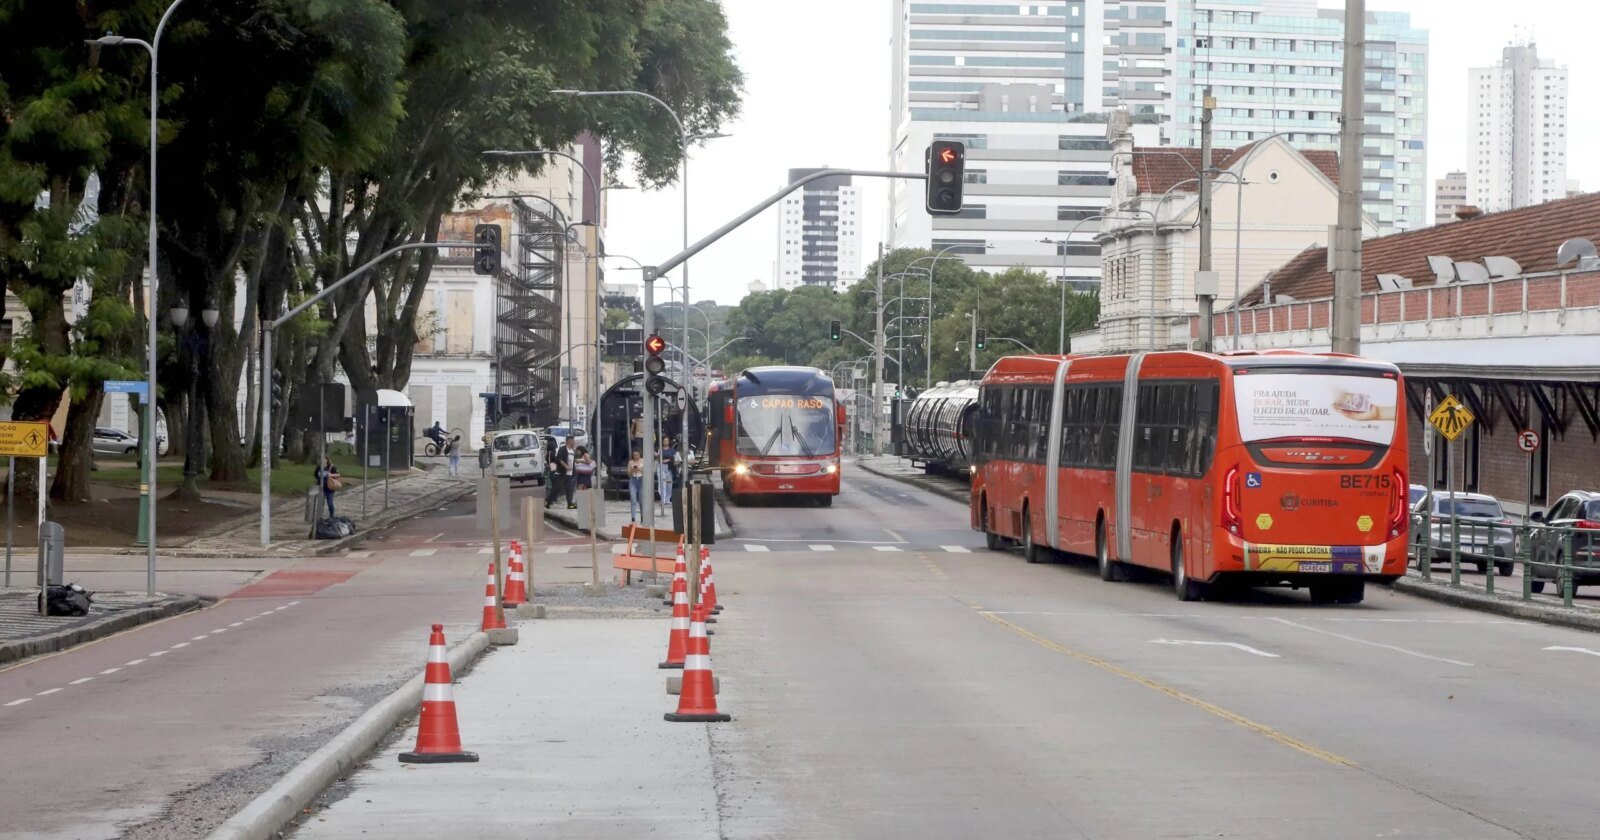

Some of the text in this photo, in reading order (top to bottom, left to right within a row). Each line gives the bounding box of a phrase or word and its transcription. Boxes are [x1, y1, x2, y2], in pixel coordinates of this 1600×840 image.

[1253, 390, 1297, 398] PRA AJUDA
[797, 400, 823, 409] RASO
[1285, 399, 1311, 407] MUDE
[1260, 407, 1284, 415] JEITO
[1285, 407, 1297, 415] DE
[1340, 474, 1390, 489] BE715
[1301, 499, 1339, 507] CURITIBA
[1288, 546, 1305, 554] PEGUE
